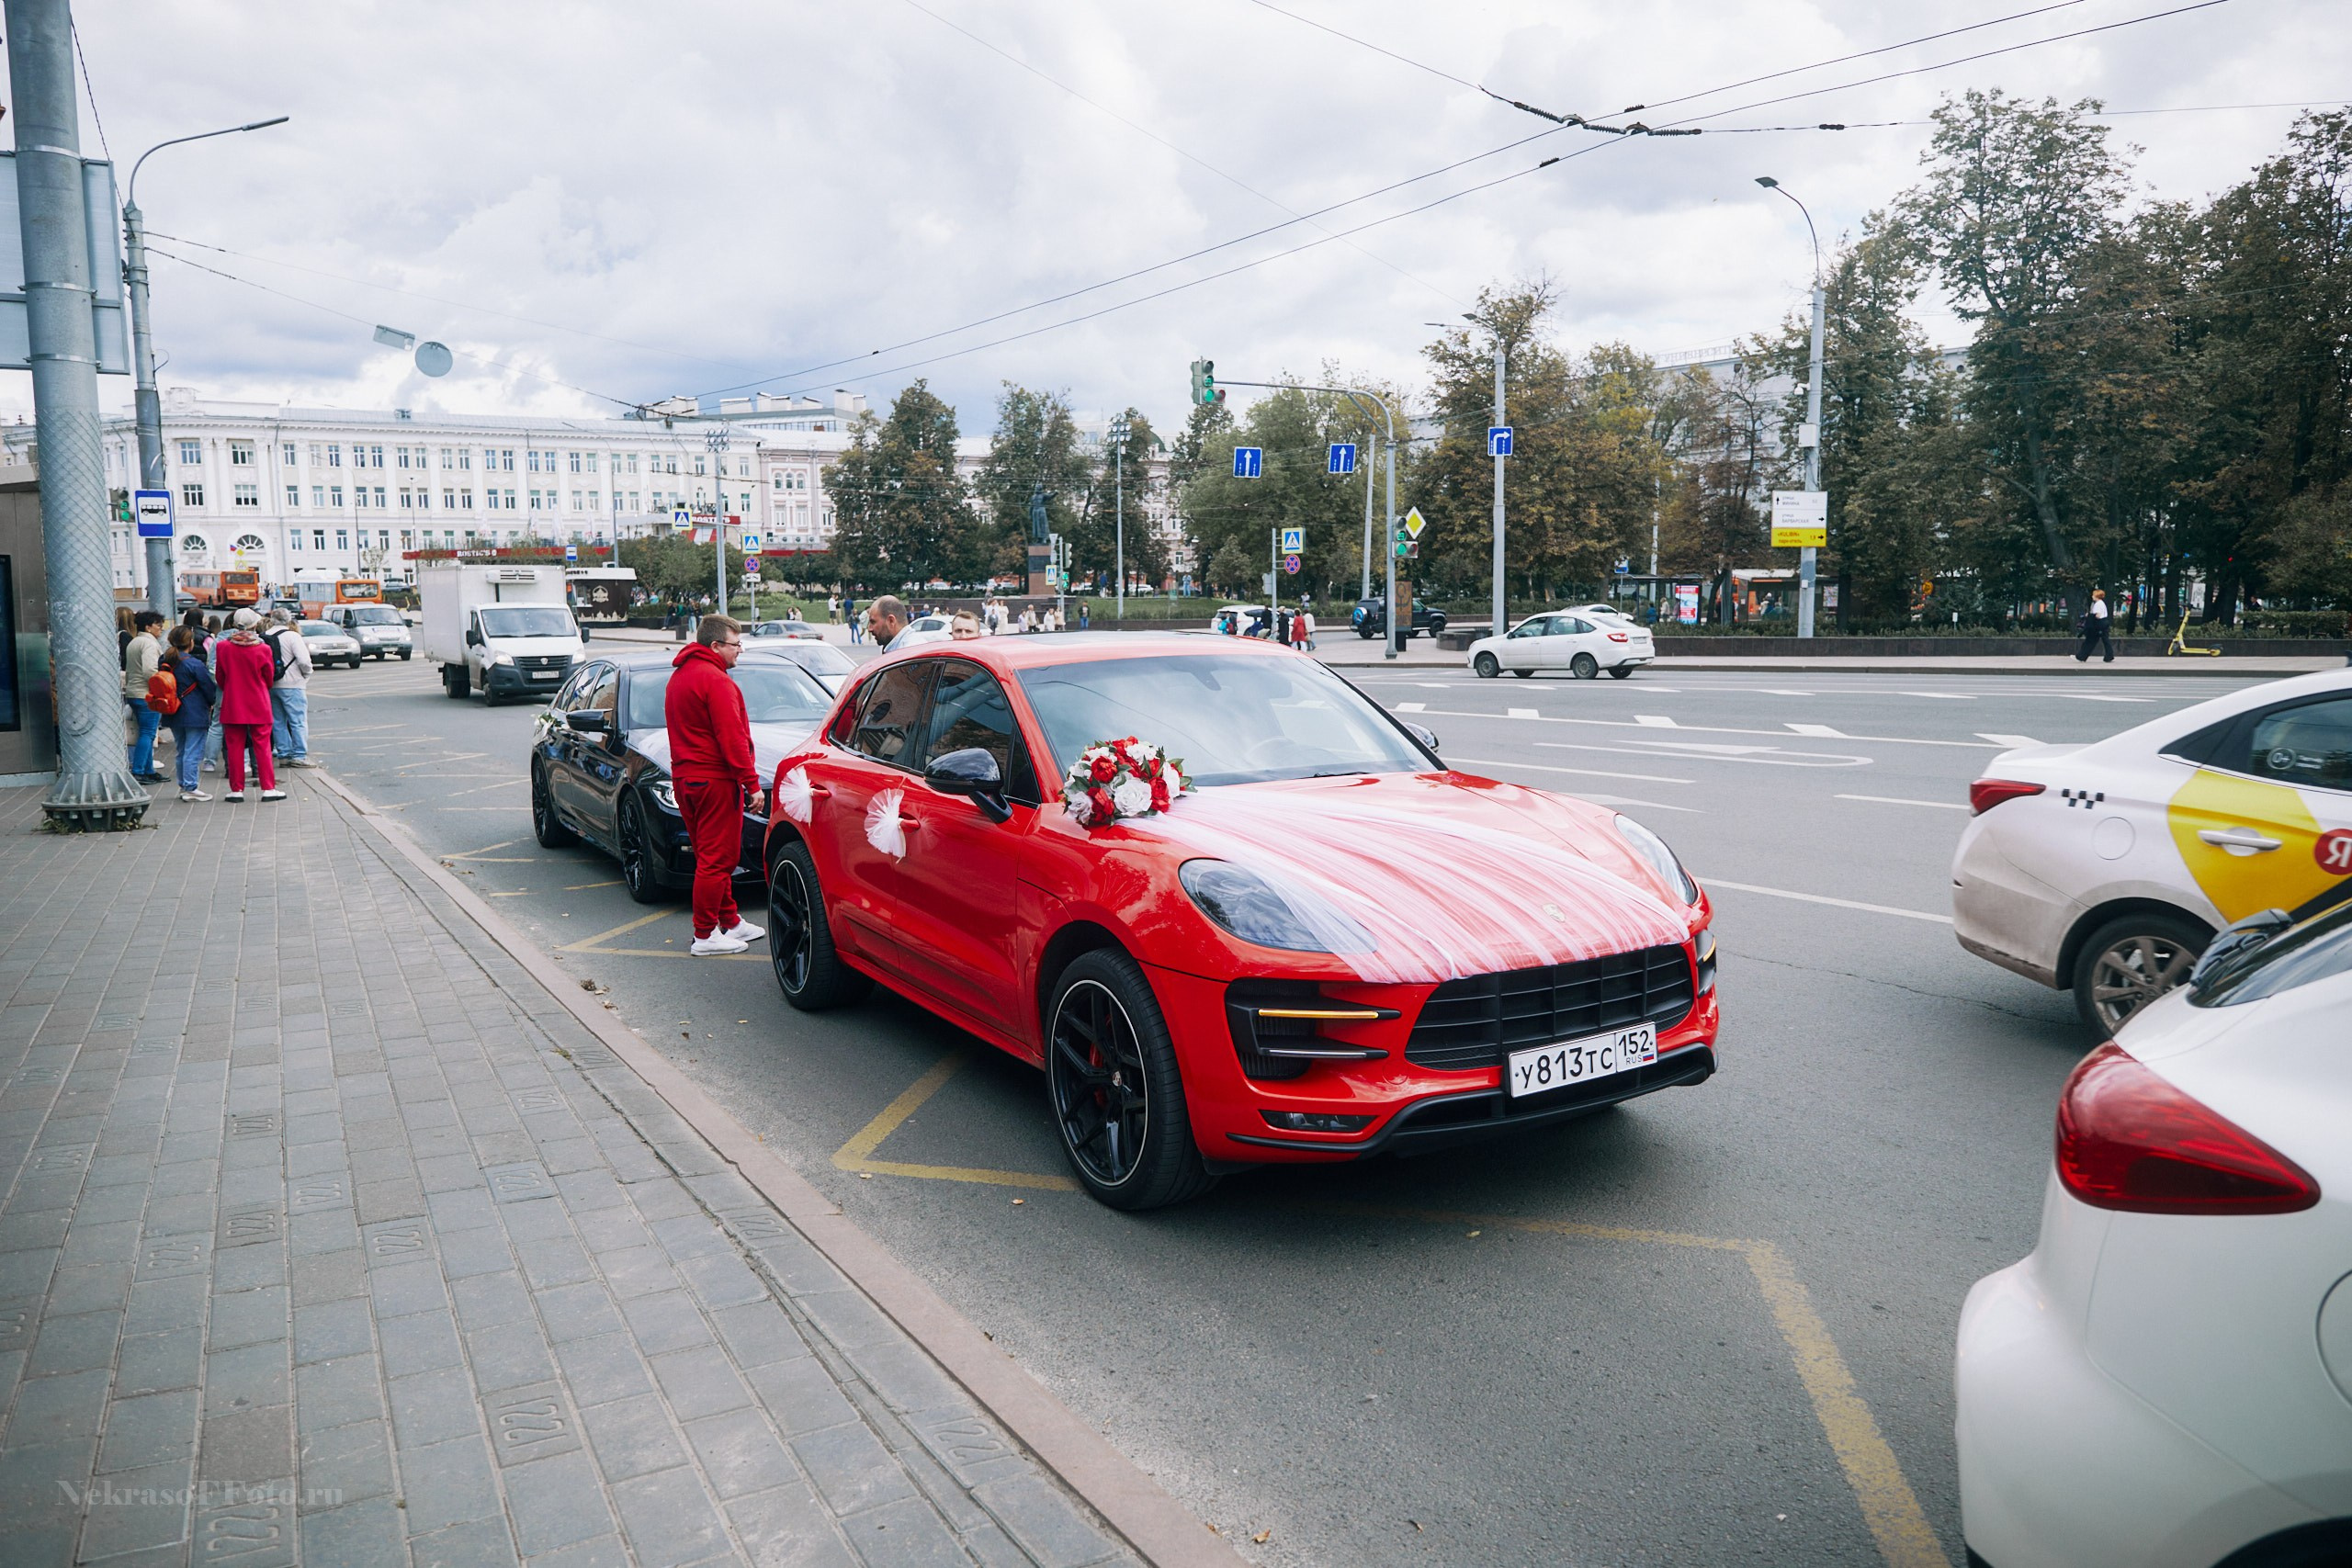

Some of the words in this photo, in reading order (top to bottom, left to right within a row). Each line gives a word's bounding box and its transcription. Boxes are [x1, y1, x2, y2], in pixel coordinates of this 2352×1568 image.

[1521, 1046, 1613, 1089] У813ТС
[1618, 1030, 1650, 1056] 152
[1625, 1054, 1643, 1066] RUS
[371, 1224, 425, 1258] 1221
[497, 1395, 568, 1450] 1221
[925, 1416, 1015, 1467] 1221
